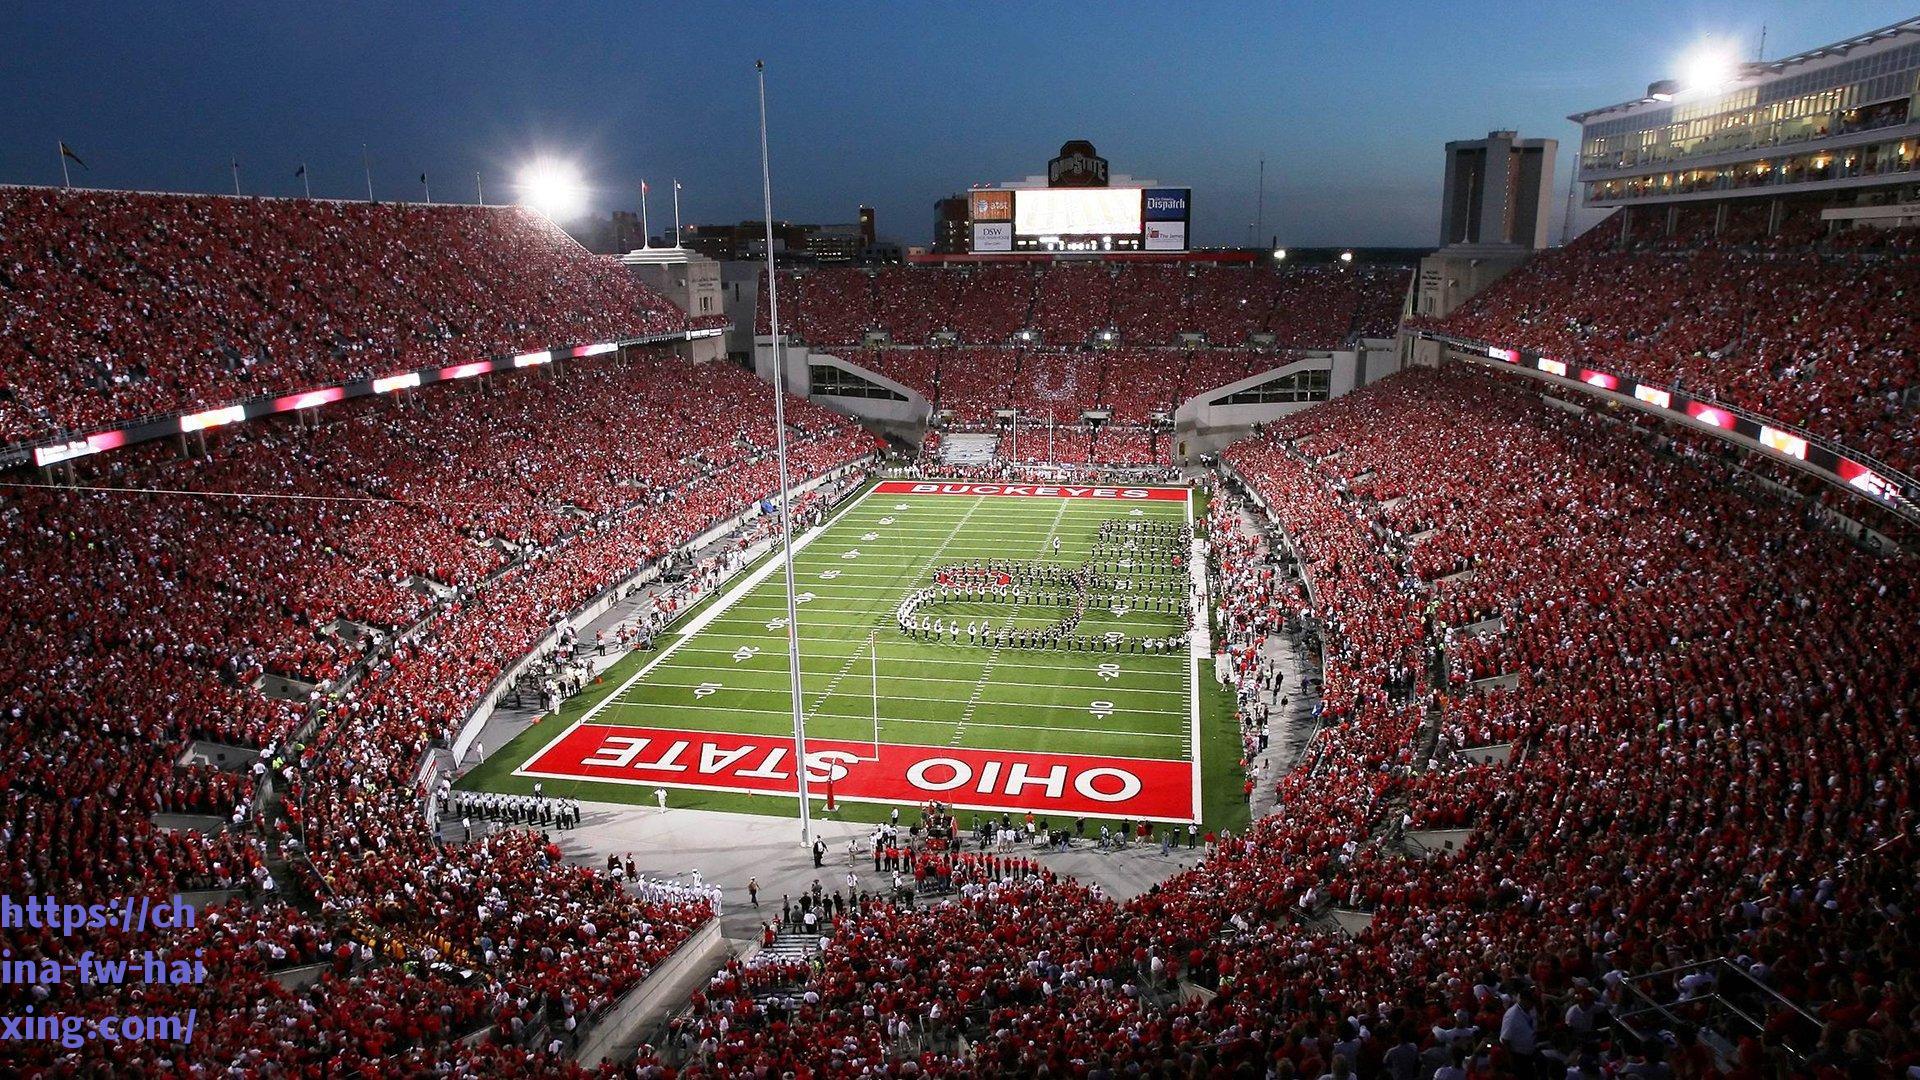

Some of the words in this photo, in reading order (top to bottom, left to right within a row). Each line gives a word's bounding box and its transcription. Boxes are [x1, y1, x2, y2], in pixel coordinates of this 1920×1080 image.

[1147, 198, 1185, 211] Dispatch
[983, 228, 1002, 236] DSW
[911, 484, 1149, 499] BUCKEYES
[732, 646, 760, 660] 20
[1097, 663, 1120, 678] 20
[693, 682, 723, 696] 10
[1089, 701, 1114, 715] 10
[580, 735, 860, 783] STATE
[905, 757, 1142, 802] OHIO
